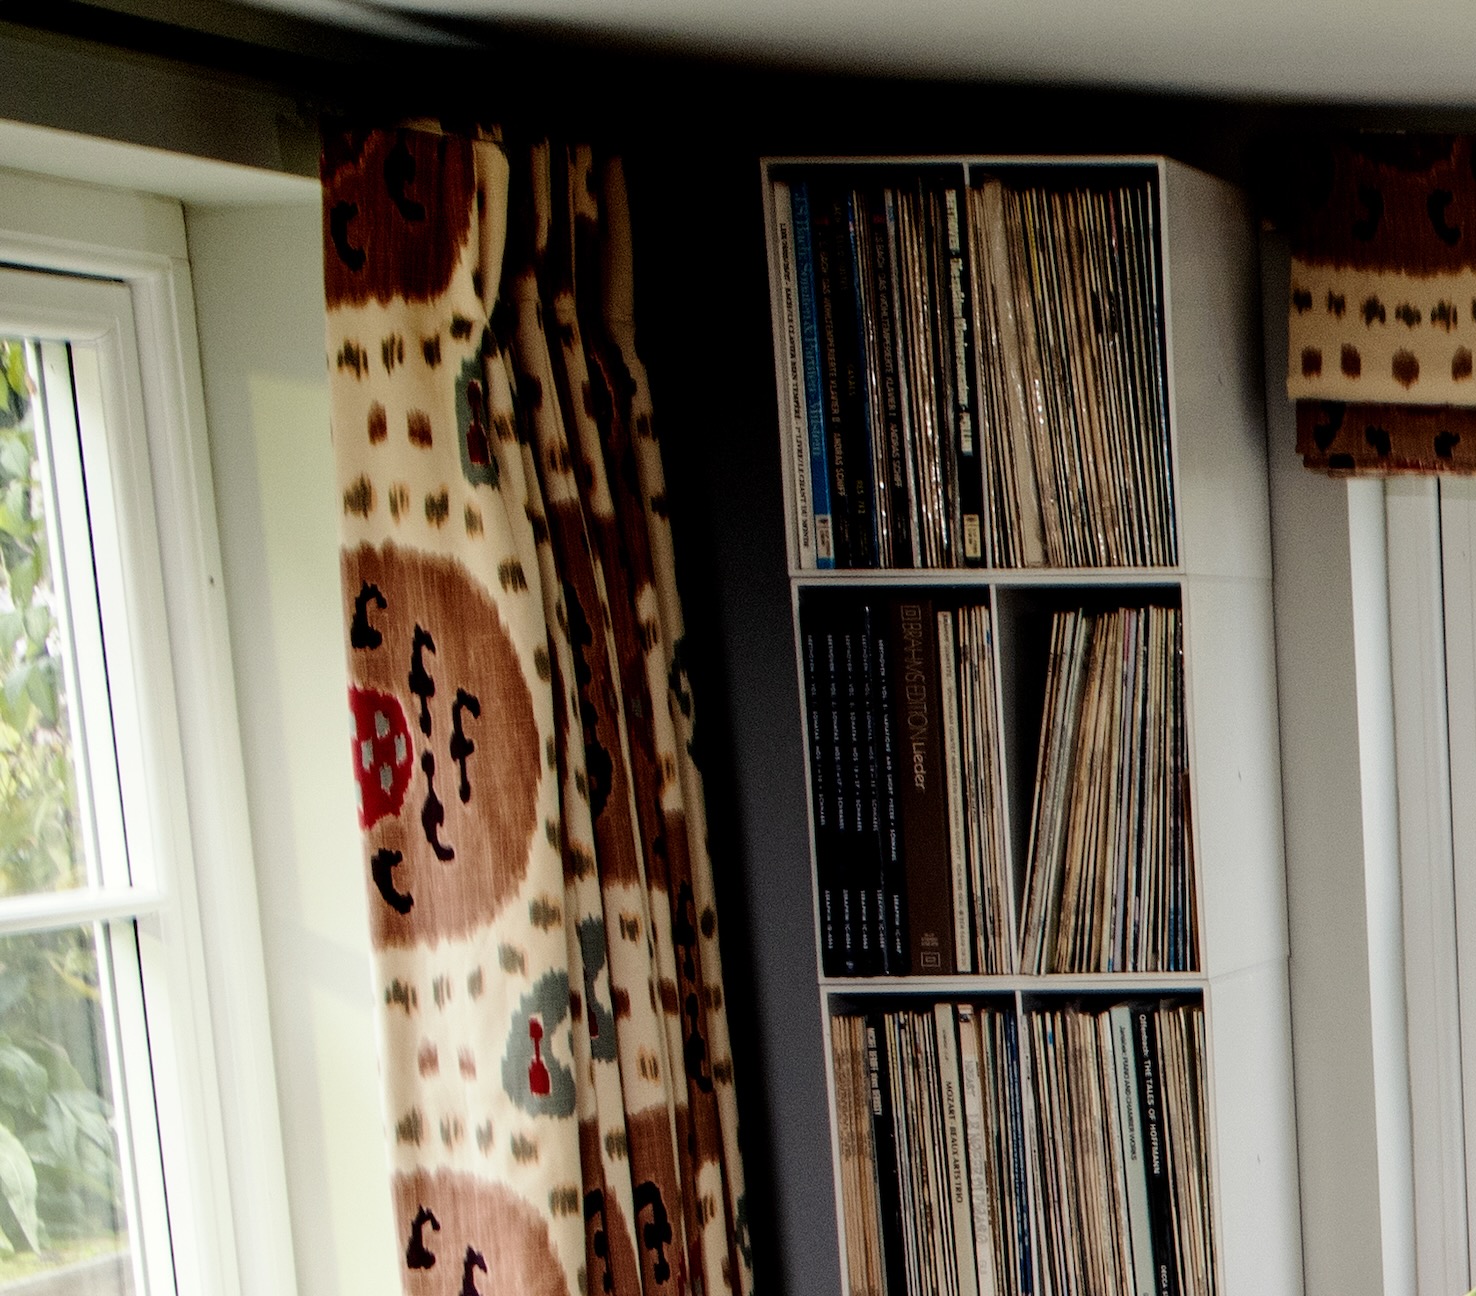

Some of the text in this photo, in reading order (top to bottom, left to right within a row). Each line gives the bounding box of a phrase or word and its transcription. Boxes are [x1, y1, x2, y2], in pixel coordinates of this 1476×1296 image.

[891, 459, 902, 488] SCHIFF
[901, 620, 928, 793] BRAHMS EDITION Lieder
[944, 1080, 963, 1204] MOZART BEAUX ARTS TRIO
[1137, 1013, 1161, 1174] Offenbach: THE TALES OF HOFFMANN
[1158, 1264, 1168, 1288] DECCA
